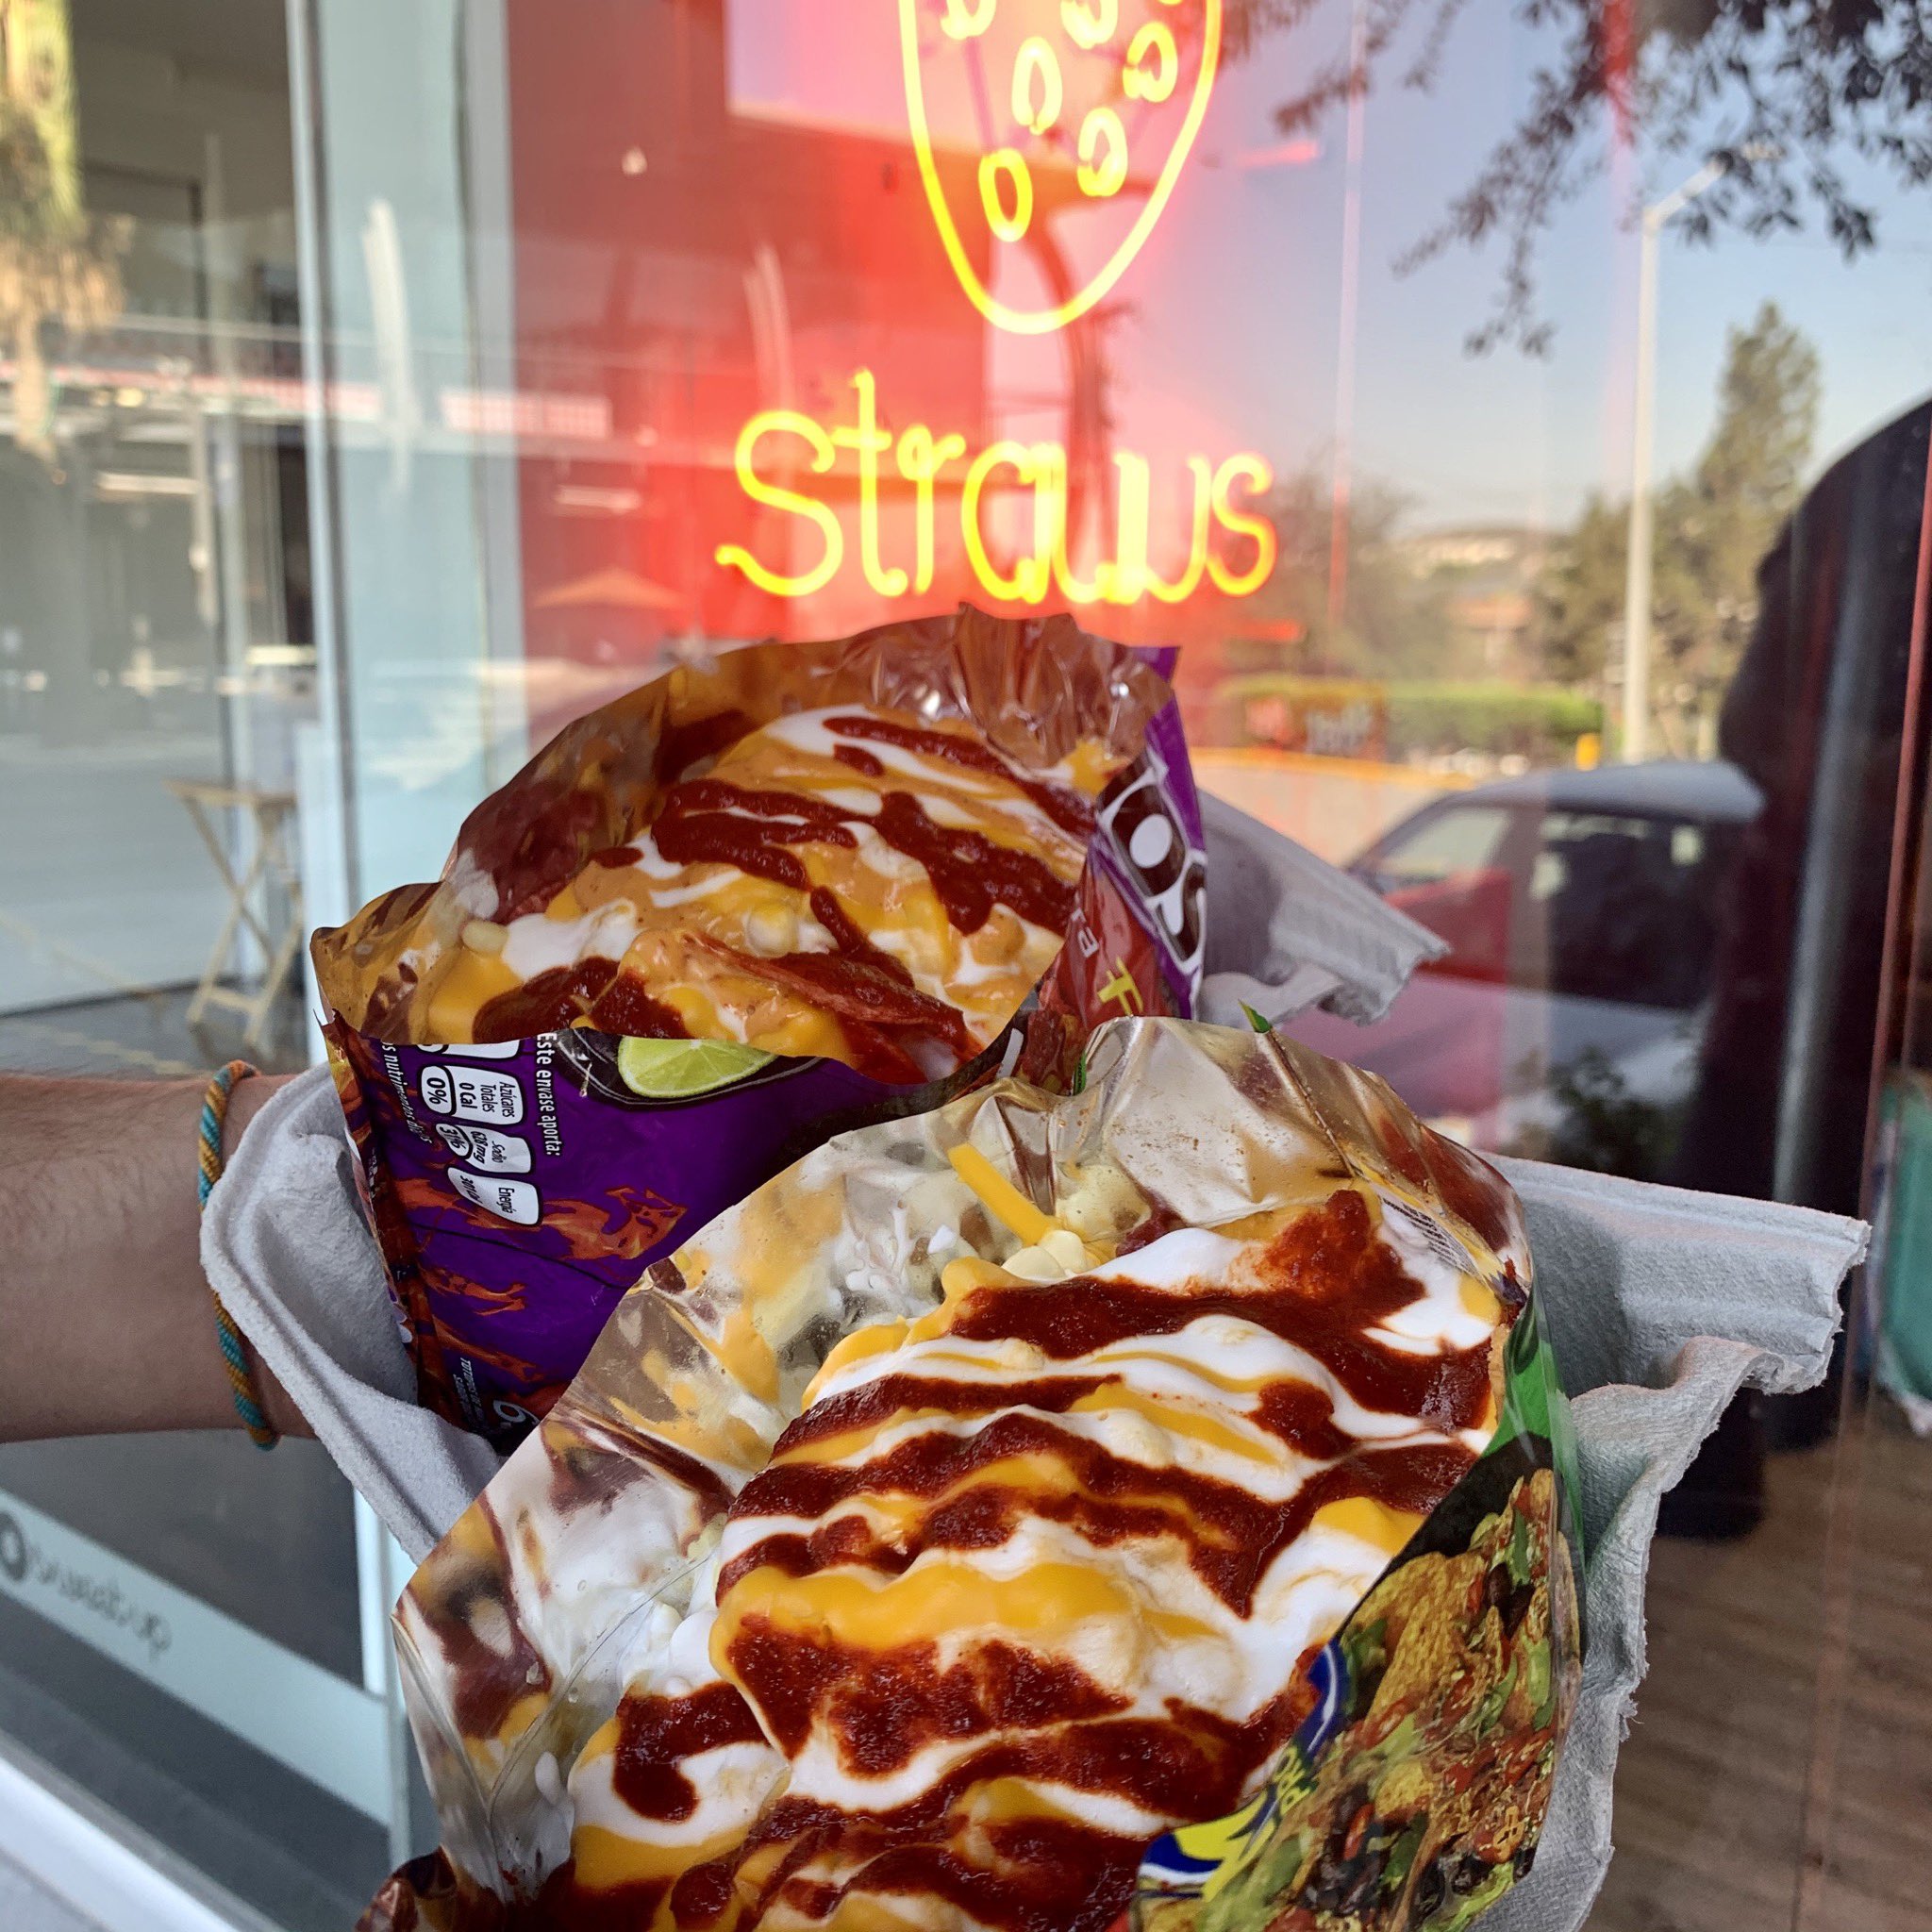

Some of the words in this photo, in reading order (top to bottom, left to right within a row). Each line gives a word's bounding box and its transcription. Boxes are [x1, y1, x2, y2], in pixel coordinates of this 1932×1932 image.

[537, 1032, 557, 1065] Este
[426, 1077, 448, 1105] 0%
[459, 1092, 477, 1108] Cal
[480, 1084, 498, 1112] Totales
[499, 1081, 517, 1118] Azúcares
[536, 1070, 556, 1111] envase
[537, 1115, 562, 1156] aporta:
[496, 1187, 517, 1214] Energía
